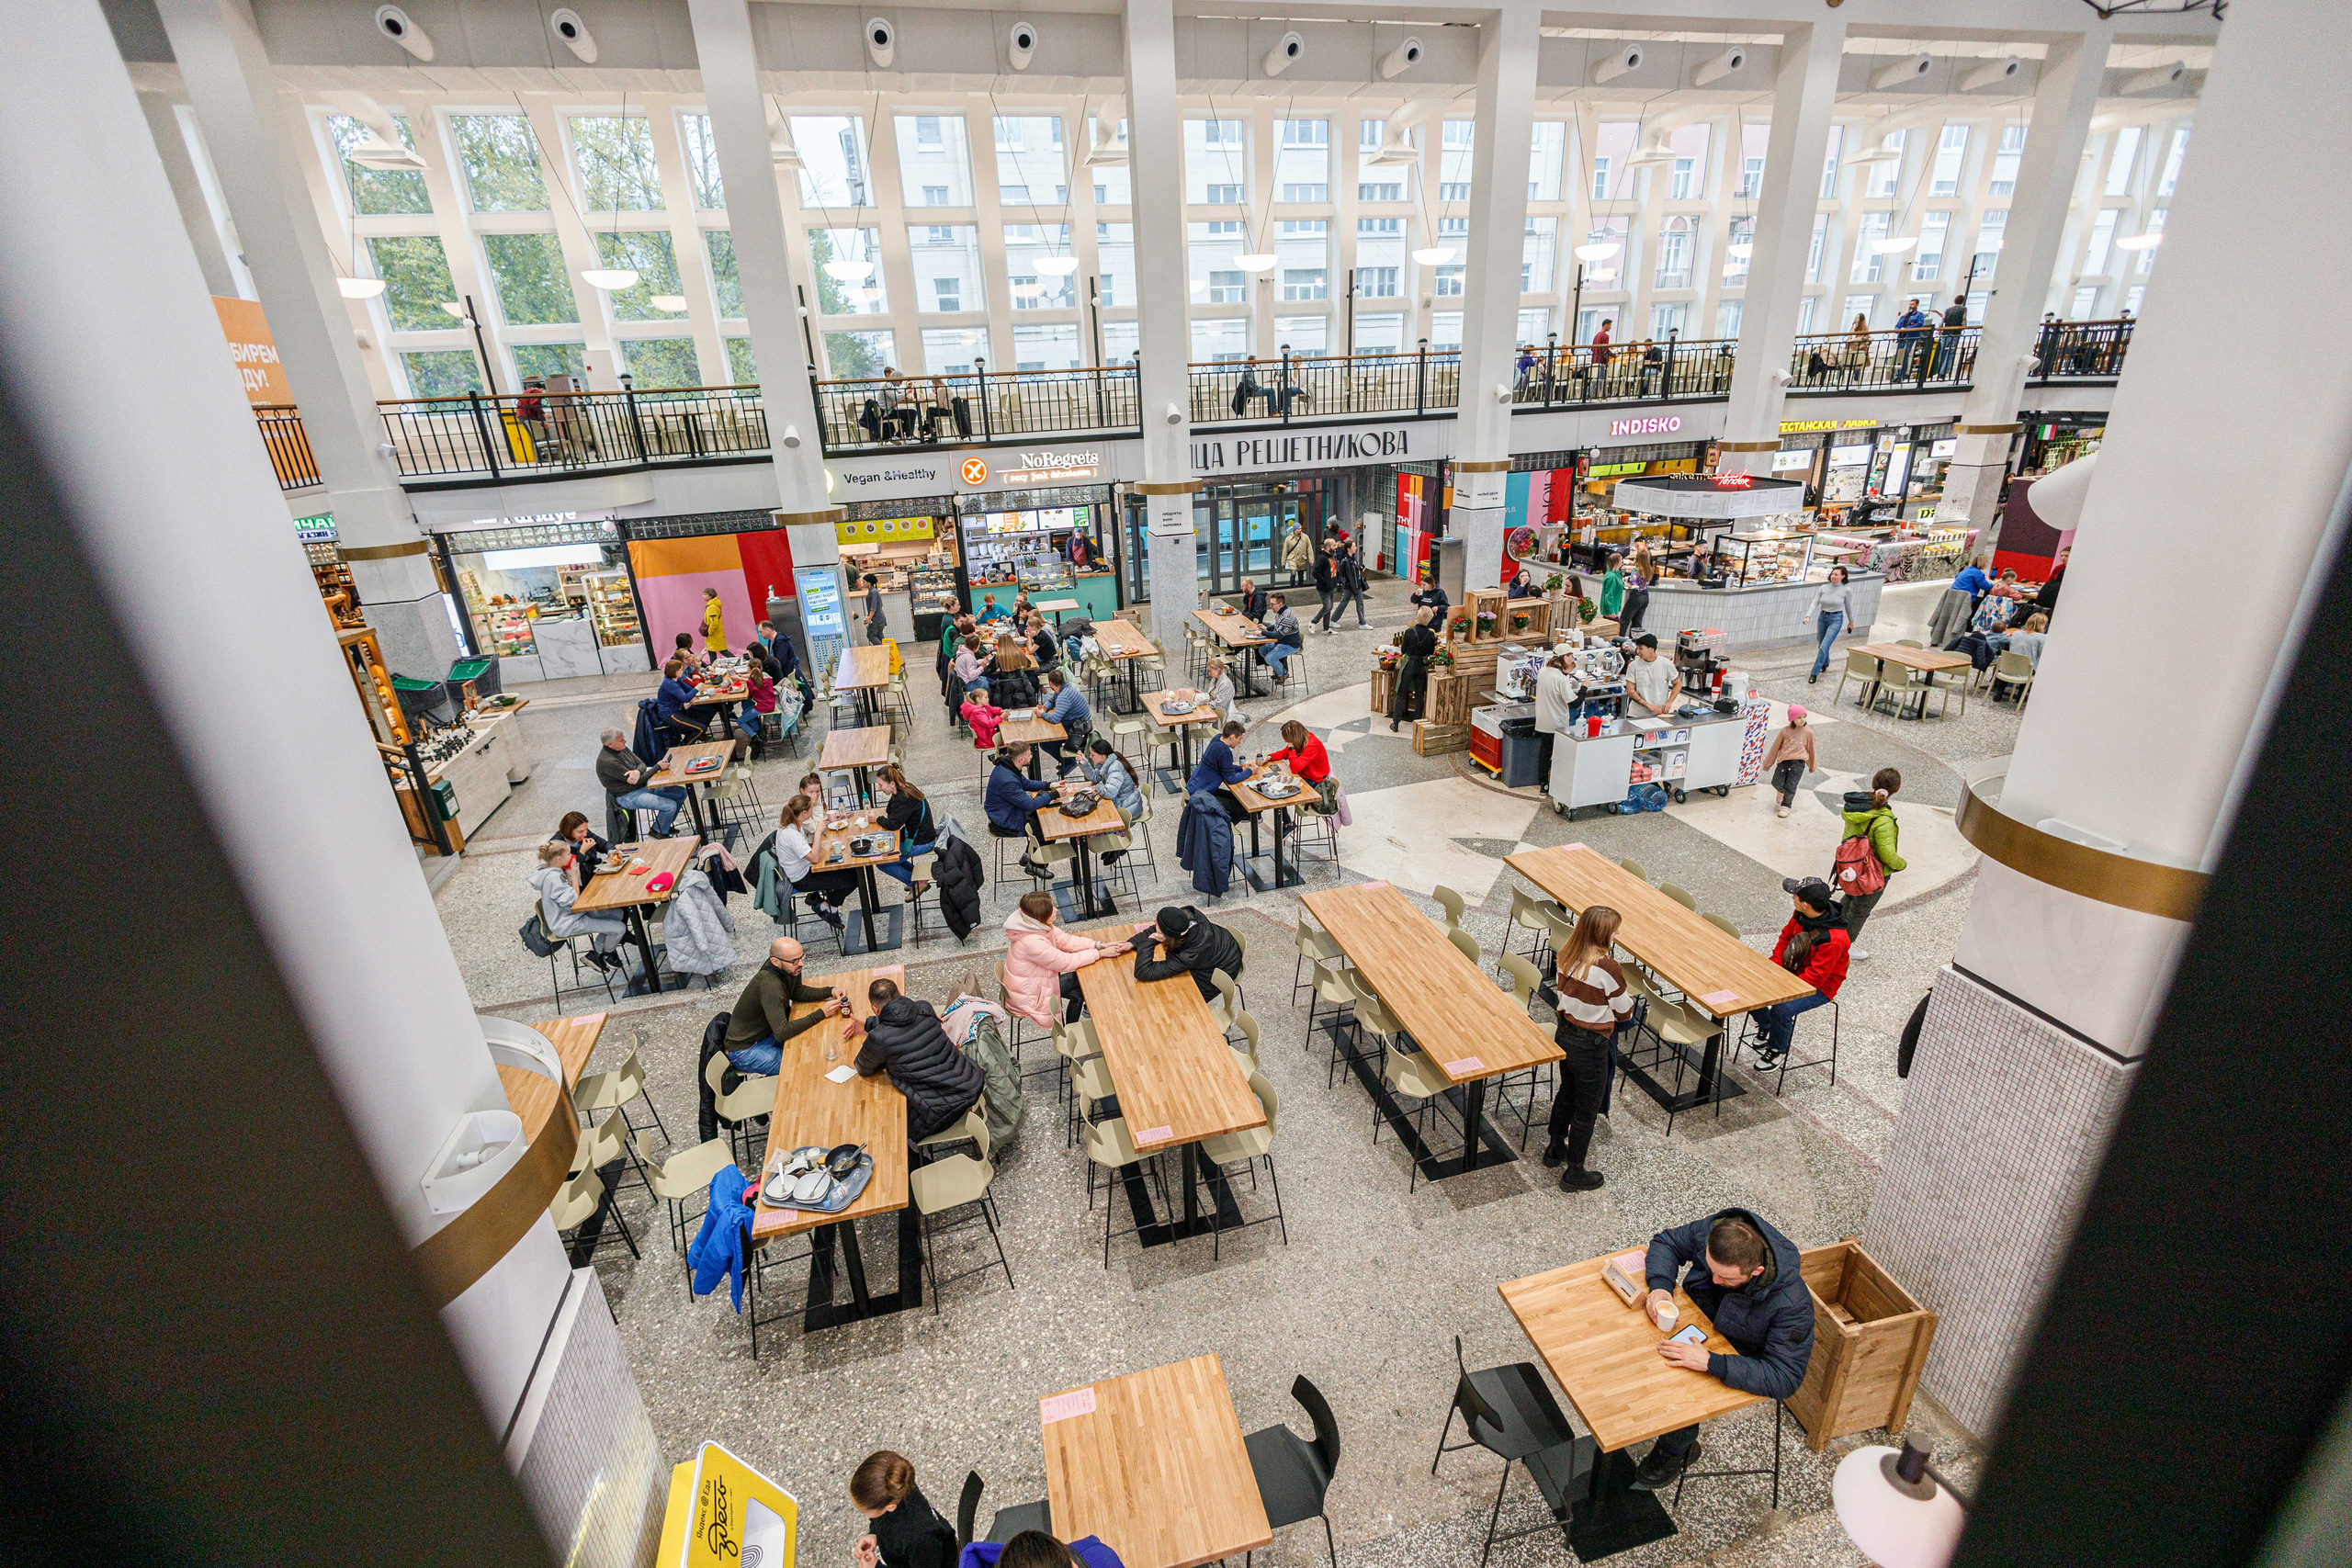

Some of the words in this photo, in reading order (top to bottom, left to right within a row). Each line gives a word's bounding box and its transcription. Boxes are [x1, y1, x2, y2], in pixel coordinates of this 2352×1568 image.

[238, 368, 270, 391] ДУ!
[1610, 416, 1681, 435] INDISKO
[1019, 449, 1100, 469] NoRegrets
[1190, 443, 1225, 470] ЦА
[1237, 430, 1408, 466] РЕШЕТНИКОВА
[843, 474, 880, 485] Vegan
[1396, 515, 1411, 525] THY
[696, 1507, 707, 1540] Яндекс
[703, 1480, 711, 1496] Еда
